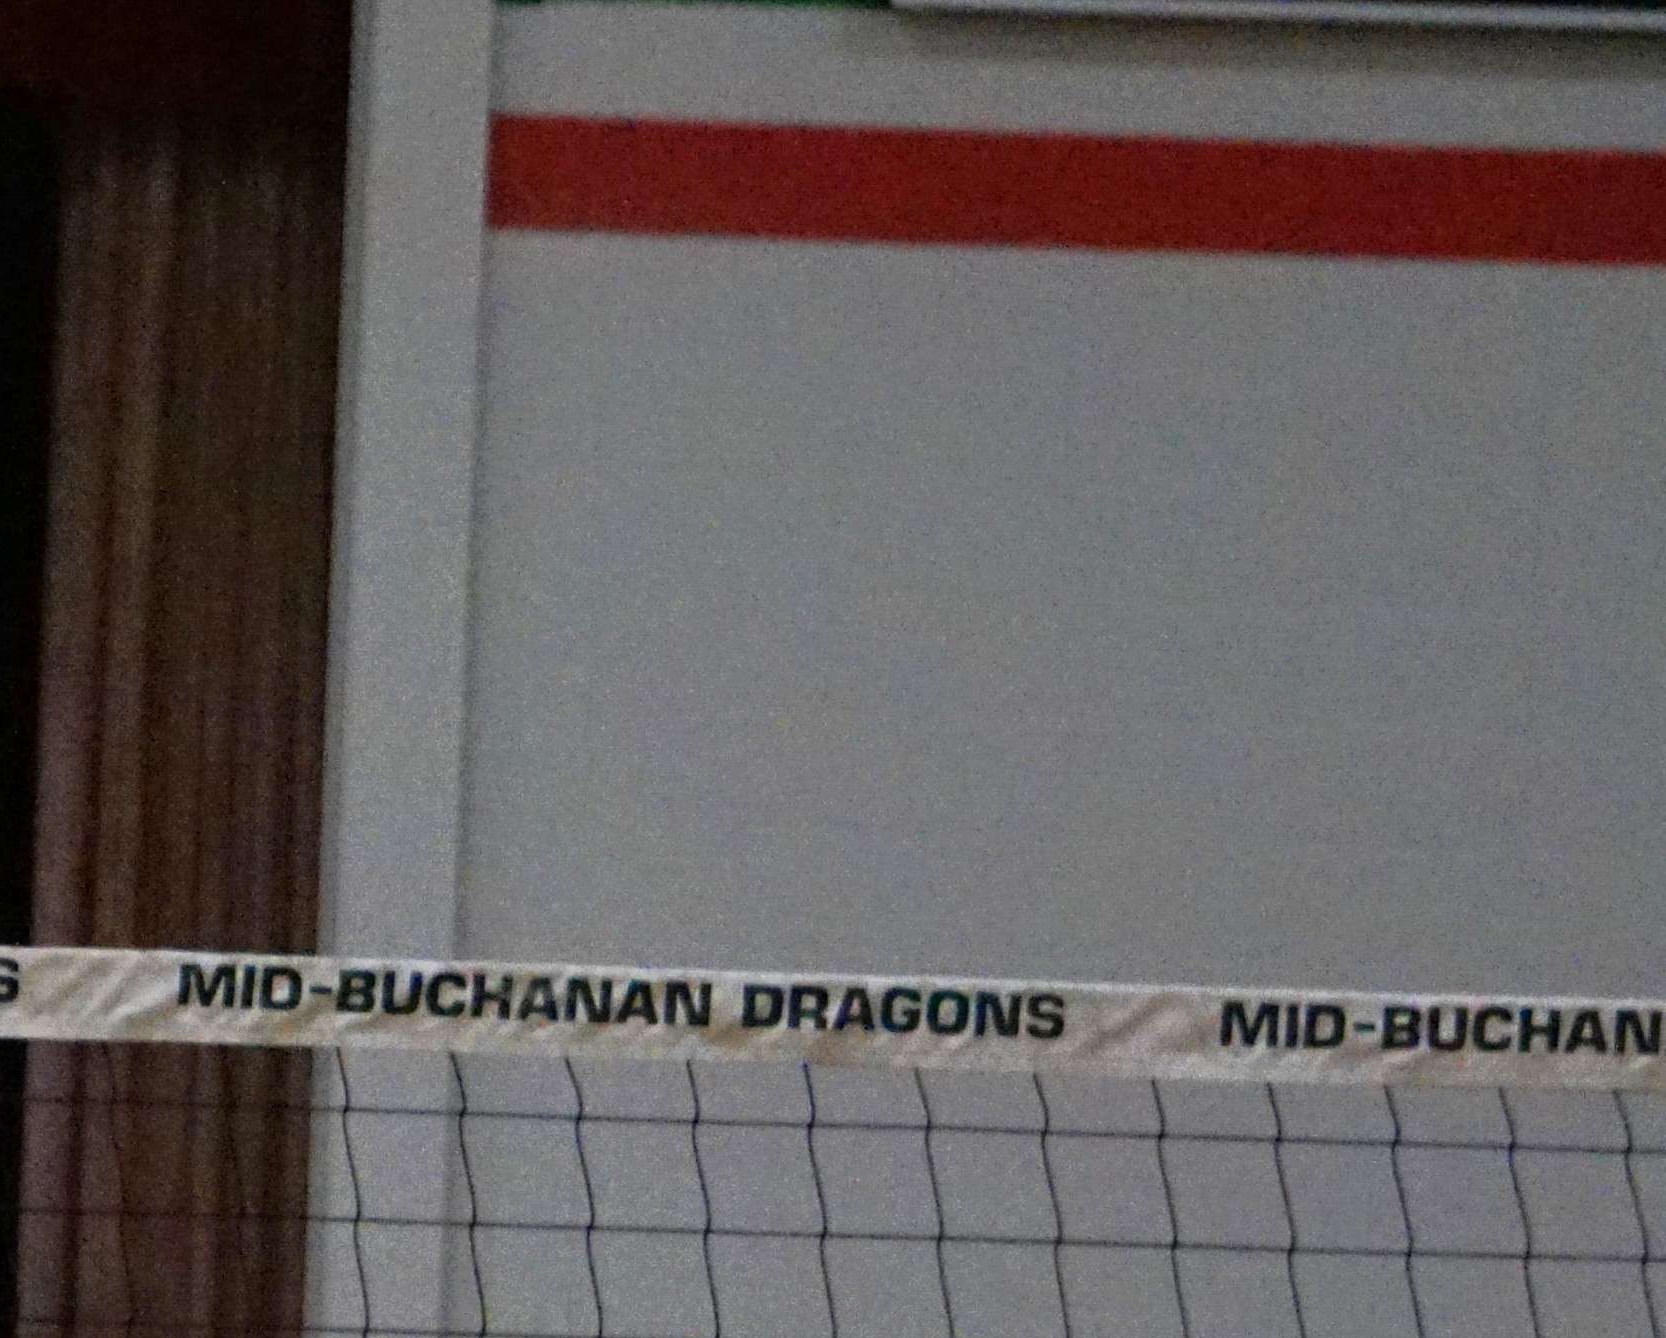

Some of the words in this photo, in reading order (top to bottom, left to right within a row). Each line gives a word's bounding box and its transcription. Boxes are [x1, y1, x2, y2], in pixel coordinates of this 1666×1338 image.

[177, 963, 713, 1027] MID-BUCHANAN
[740, 984, 1068, 1040] DRAGONS
[1218, 1000, 1666, 1055] MID-BUCHAN
